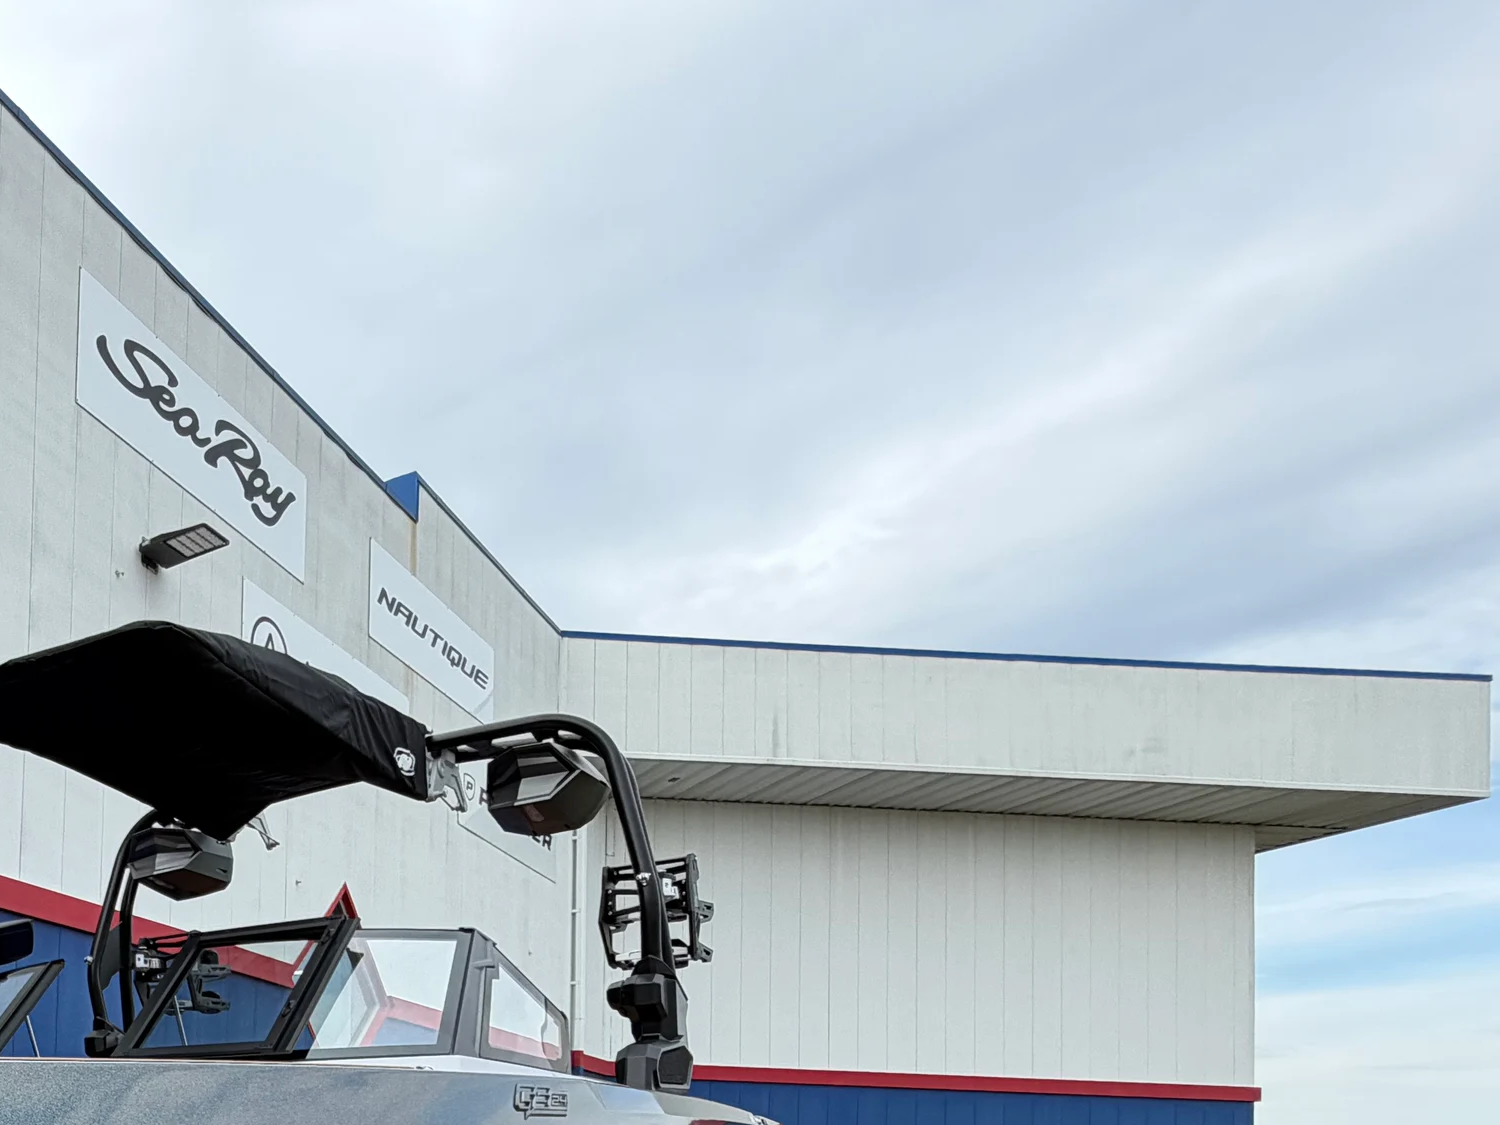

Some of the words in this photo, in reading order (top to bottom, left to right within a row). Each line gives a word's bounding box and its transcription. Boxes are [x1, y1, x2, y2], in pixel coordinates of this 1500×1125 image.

[96, 334, 211, 448] Sea
[204, 419, 296, 527] Ray
[377, 587, 489, 690] NAUTIQUE
